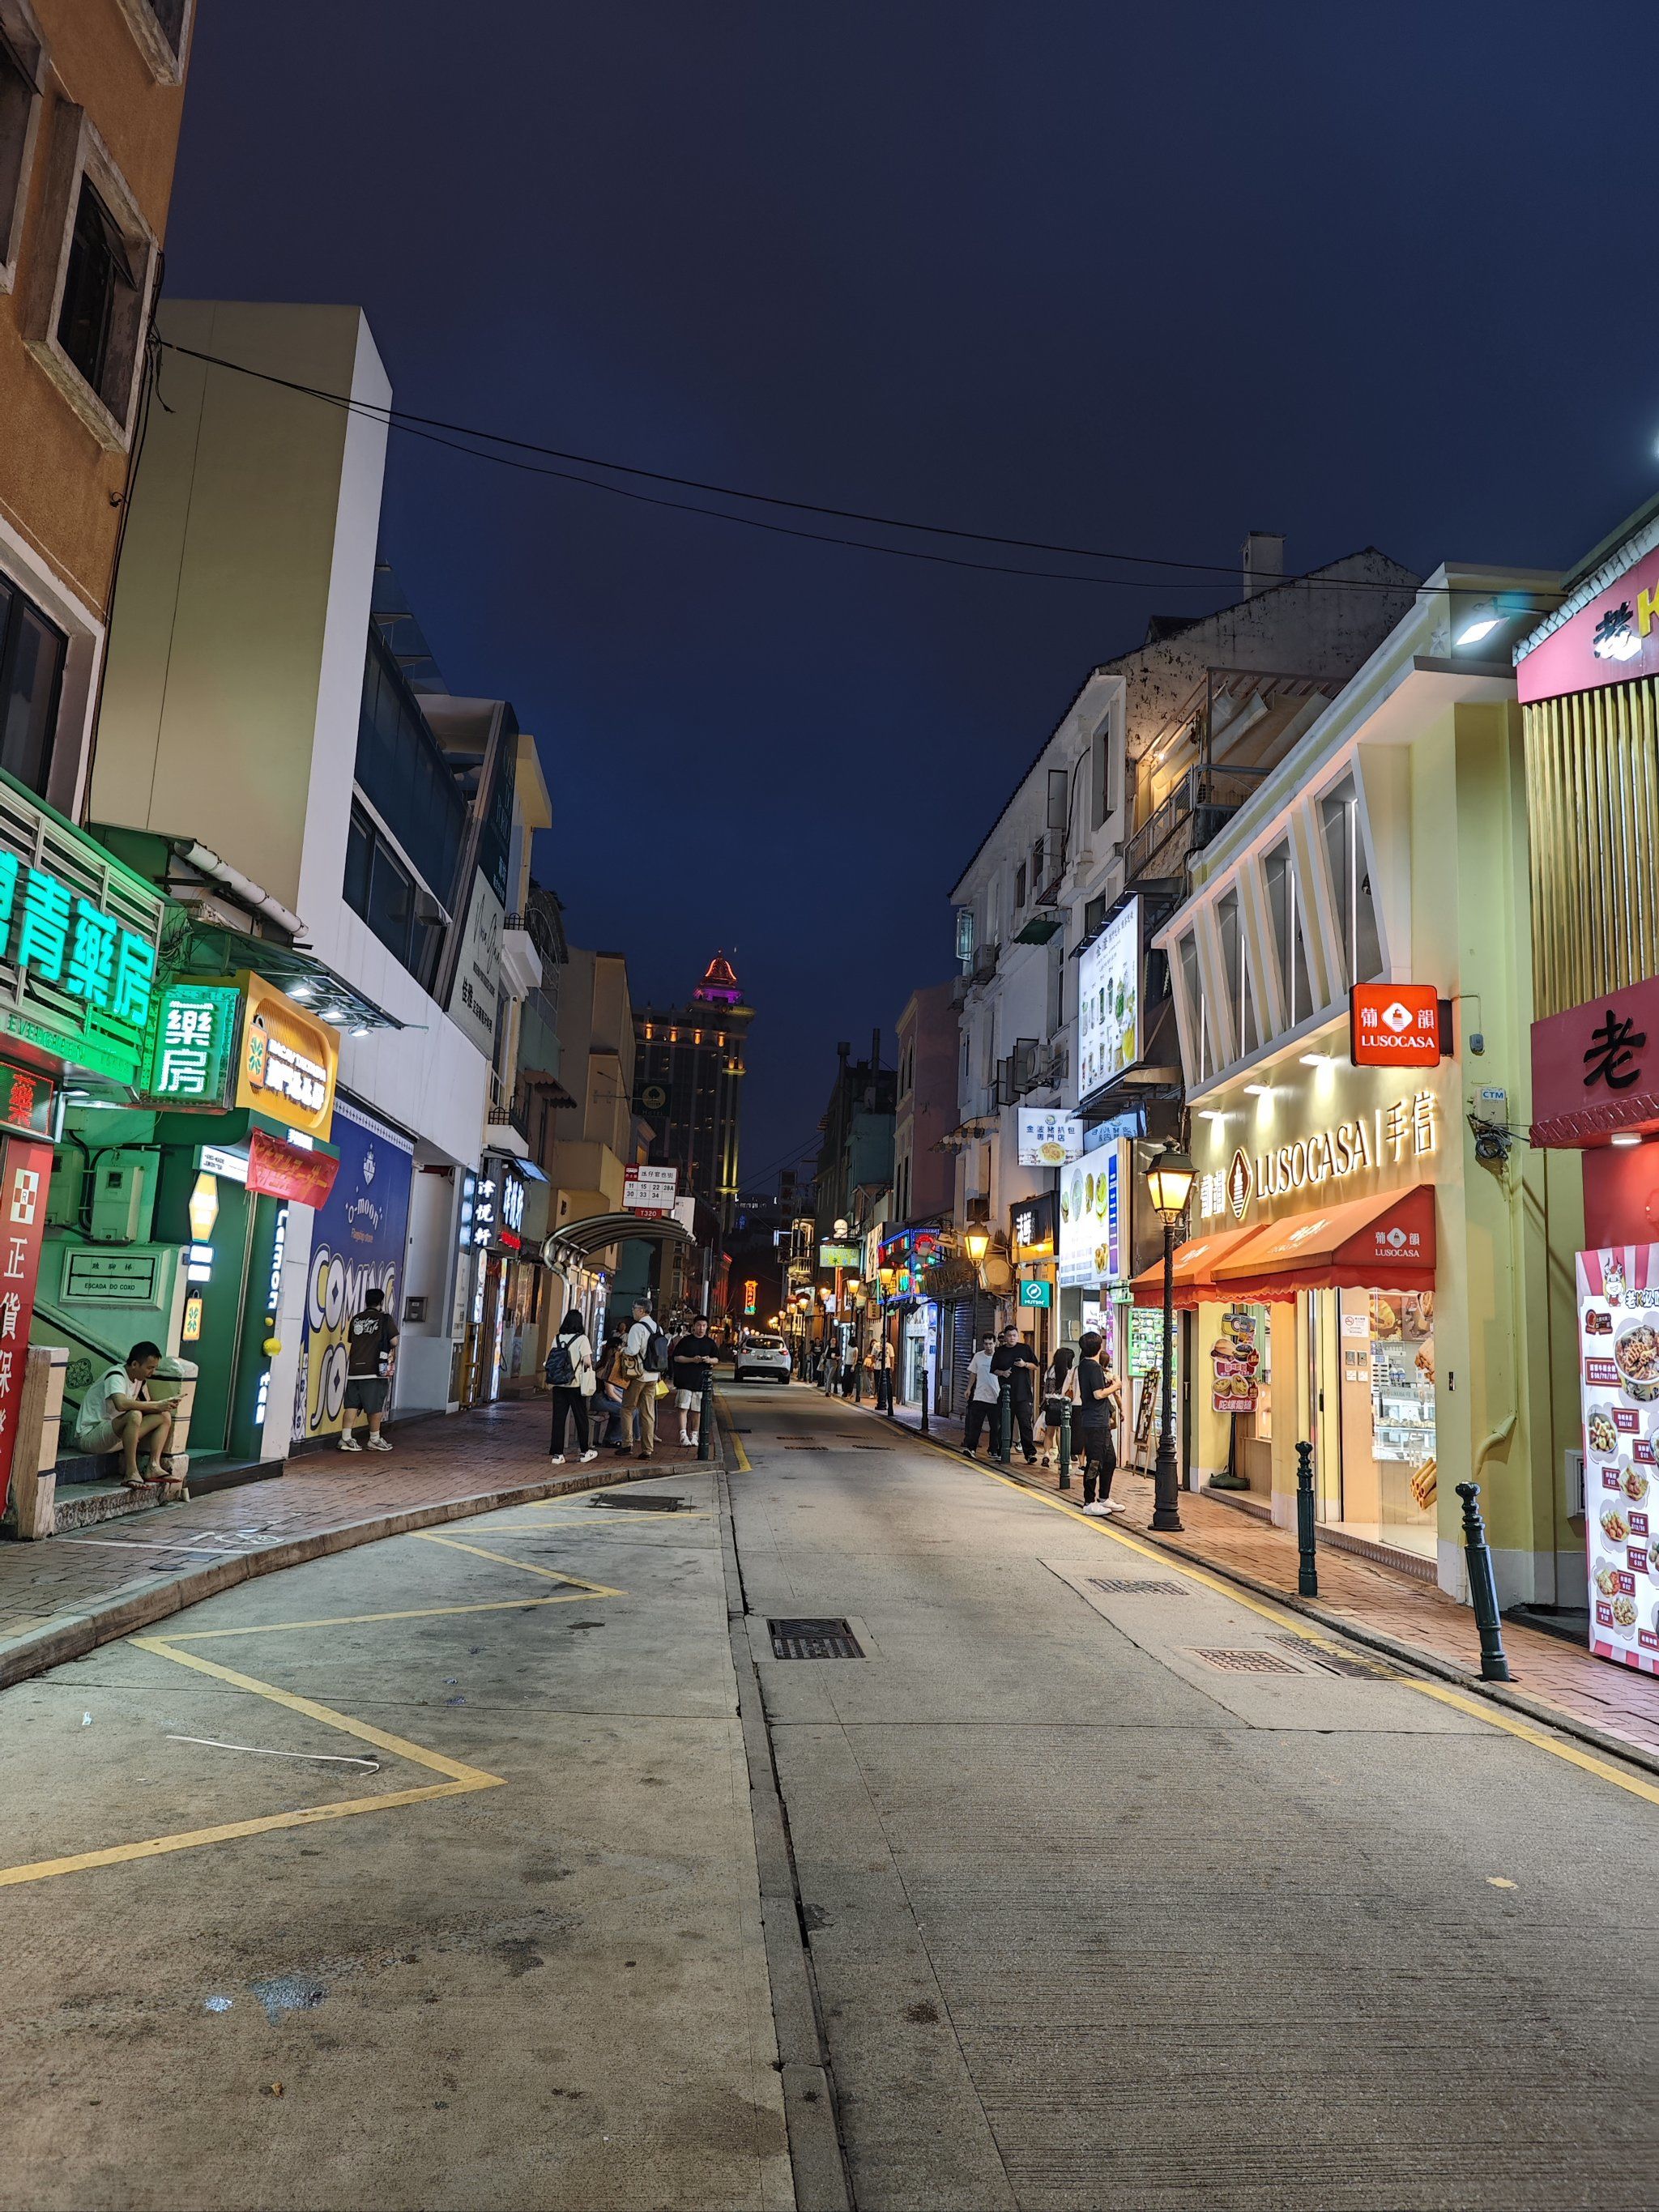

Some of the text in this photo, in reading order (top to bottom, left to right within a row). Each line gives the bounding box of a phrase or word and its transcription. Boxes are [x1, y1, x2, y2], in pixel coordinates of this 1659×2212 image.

[1361, 1008, 1435, 1029] 葡 韻
[1361, 1034, 1435, 1048] LUSOCASA
[158, 1000, 211, 1093] 藥房
[1584, 1009, 1647, 1089] 老
[1482, 1091, 1504, 1099] CTM
[1256, 1118, 1372, 1200] LUSOCASA
[1386, 1090, 1437, 1163] 手信
[1375, 1248, 1420, 1257] LUSOCASA
[0, 1238, 28, 1455] 正貨保
